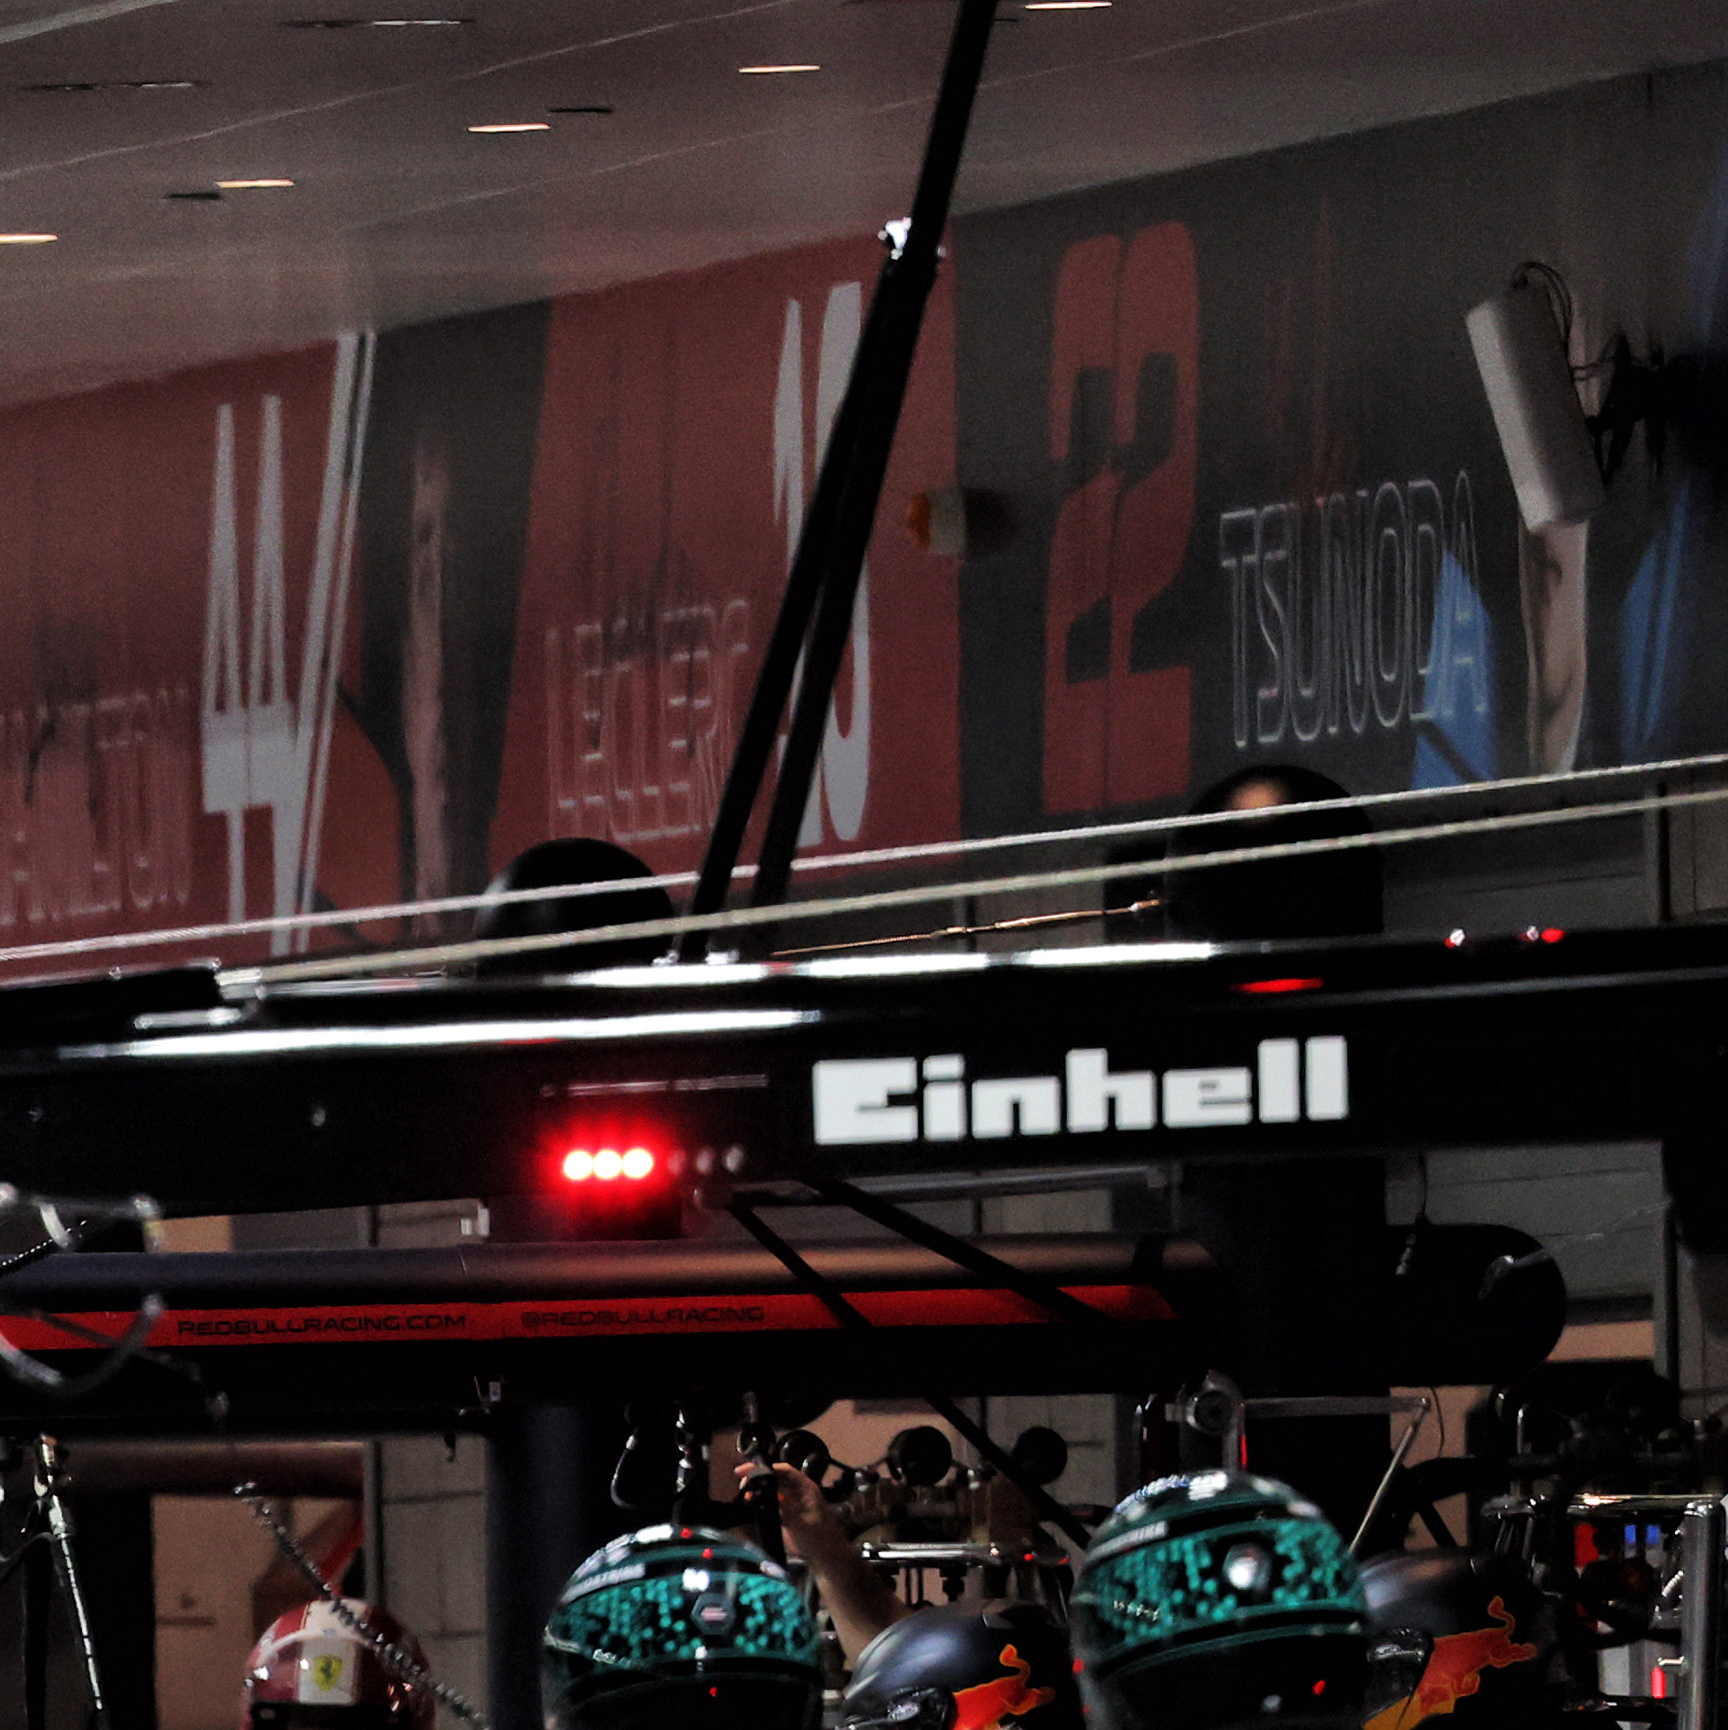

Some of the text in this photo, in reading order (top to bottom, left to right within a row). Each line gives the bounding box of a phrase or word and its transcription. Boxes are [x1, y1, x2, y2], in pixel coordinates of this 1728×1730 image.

[1219, 470, 1491, 749] TSUNODA
[812, 1036, 1348, 1146] Einhell
[177, 1313, 468, 1336] REDBULLRACING.COM
